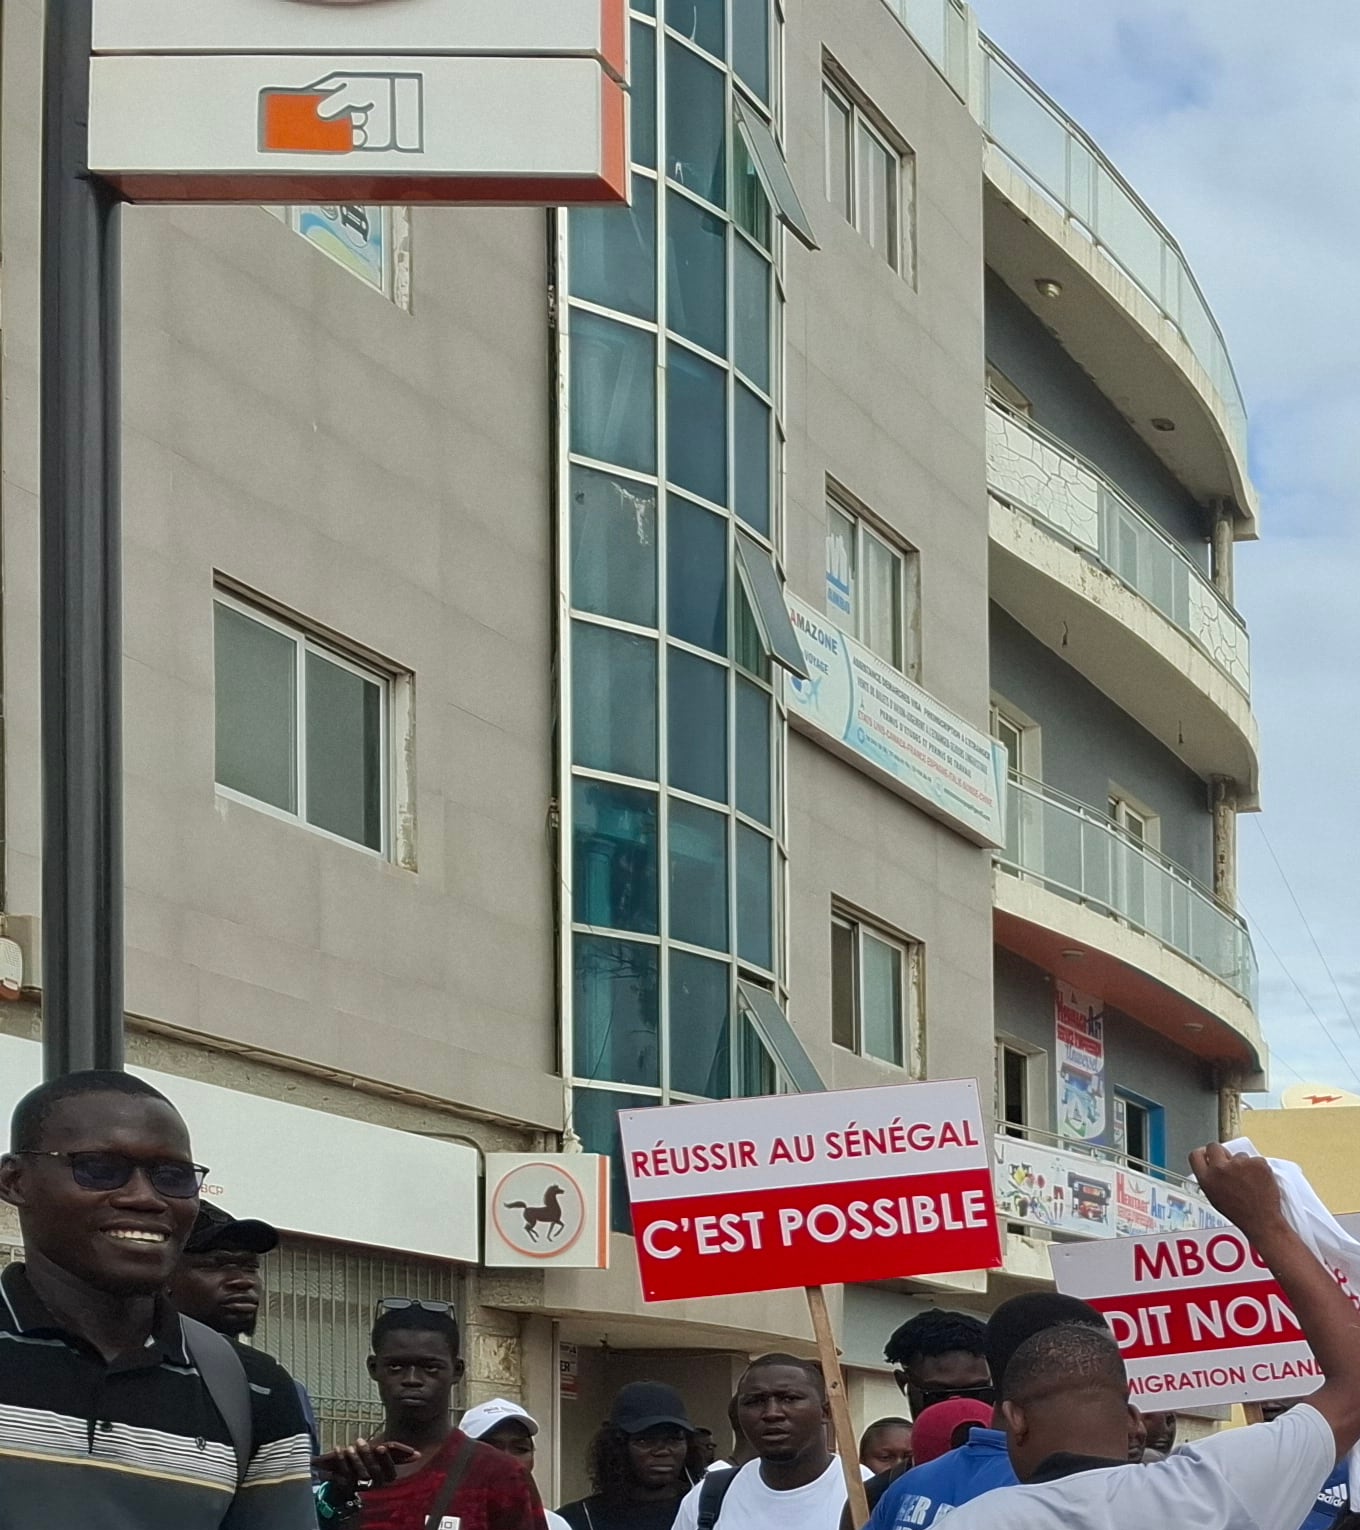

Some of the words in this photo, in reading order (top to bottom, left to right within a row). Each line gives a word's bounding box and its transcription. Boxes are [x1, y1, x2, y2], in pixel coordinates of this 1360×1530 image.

[790, 608, 838, 655] AMAZONE
[631, 1140, 757, 1178] RÉUSSIR
[769, 1134, 816, 1164] AU
[825, 1117, 979, 1159] SÉNÉGAL
[643, 1211, 764, 1259] C'EST
[779, 1190, 988, 1246] POSSIBLE
[1103, 1306, 1171, 1349] DIT
